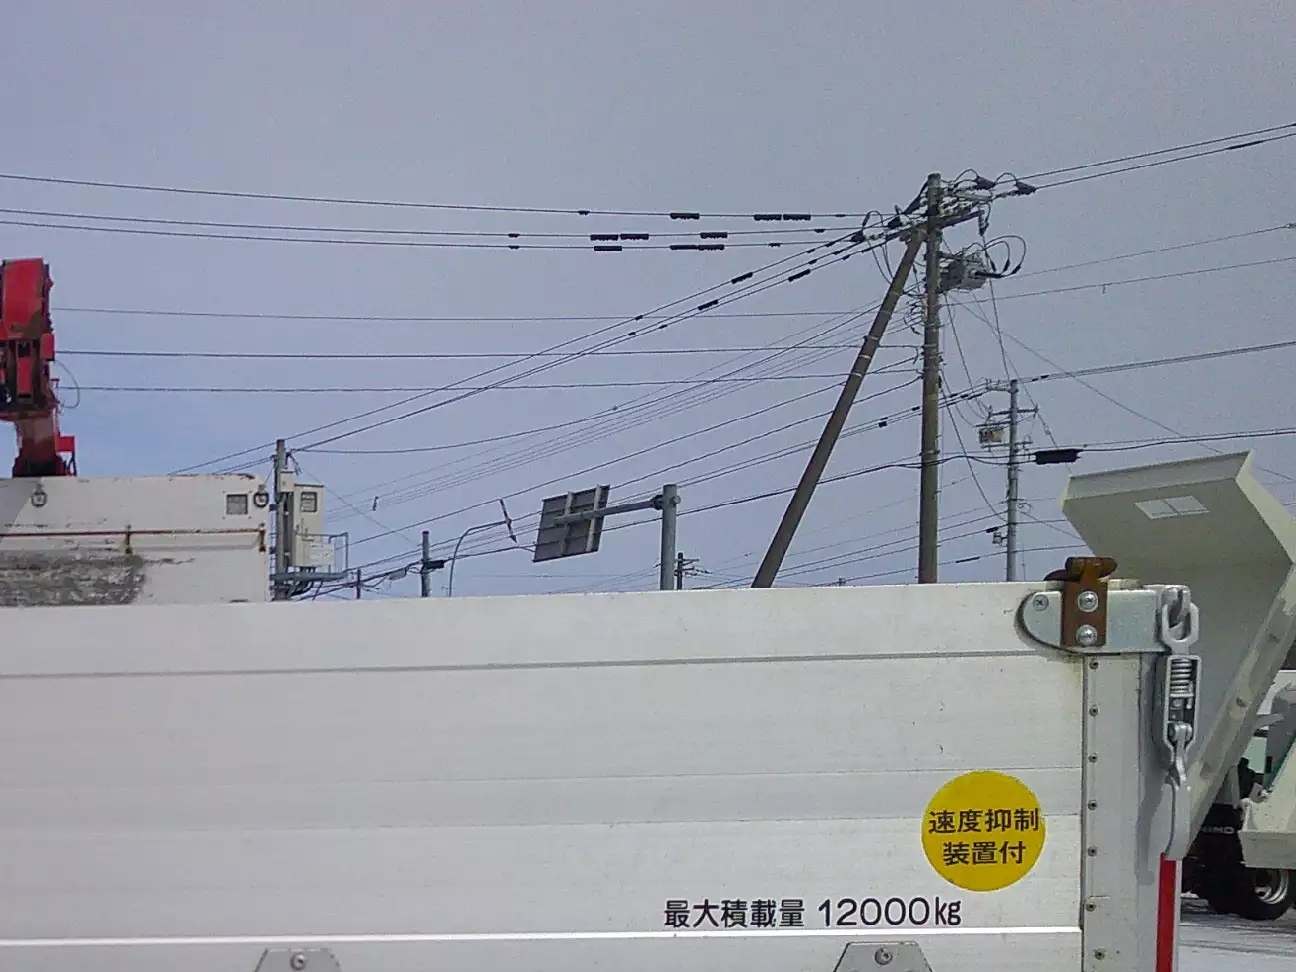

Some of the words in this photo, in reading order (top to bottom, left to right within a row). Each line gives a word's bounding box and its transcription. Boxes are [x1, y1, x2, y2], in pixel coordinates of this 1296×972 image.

[928, 807, 1040, 834] 速度抑制
[942, 840, 1027, 866] 装置付
[663, 898, 806, 928] 最大積載量
[817, 896, 962, 927] 12000kg
